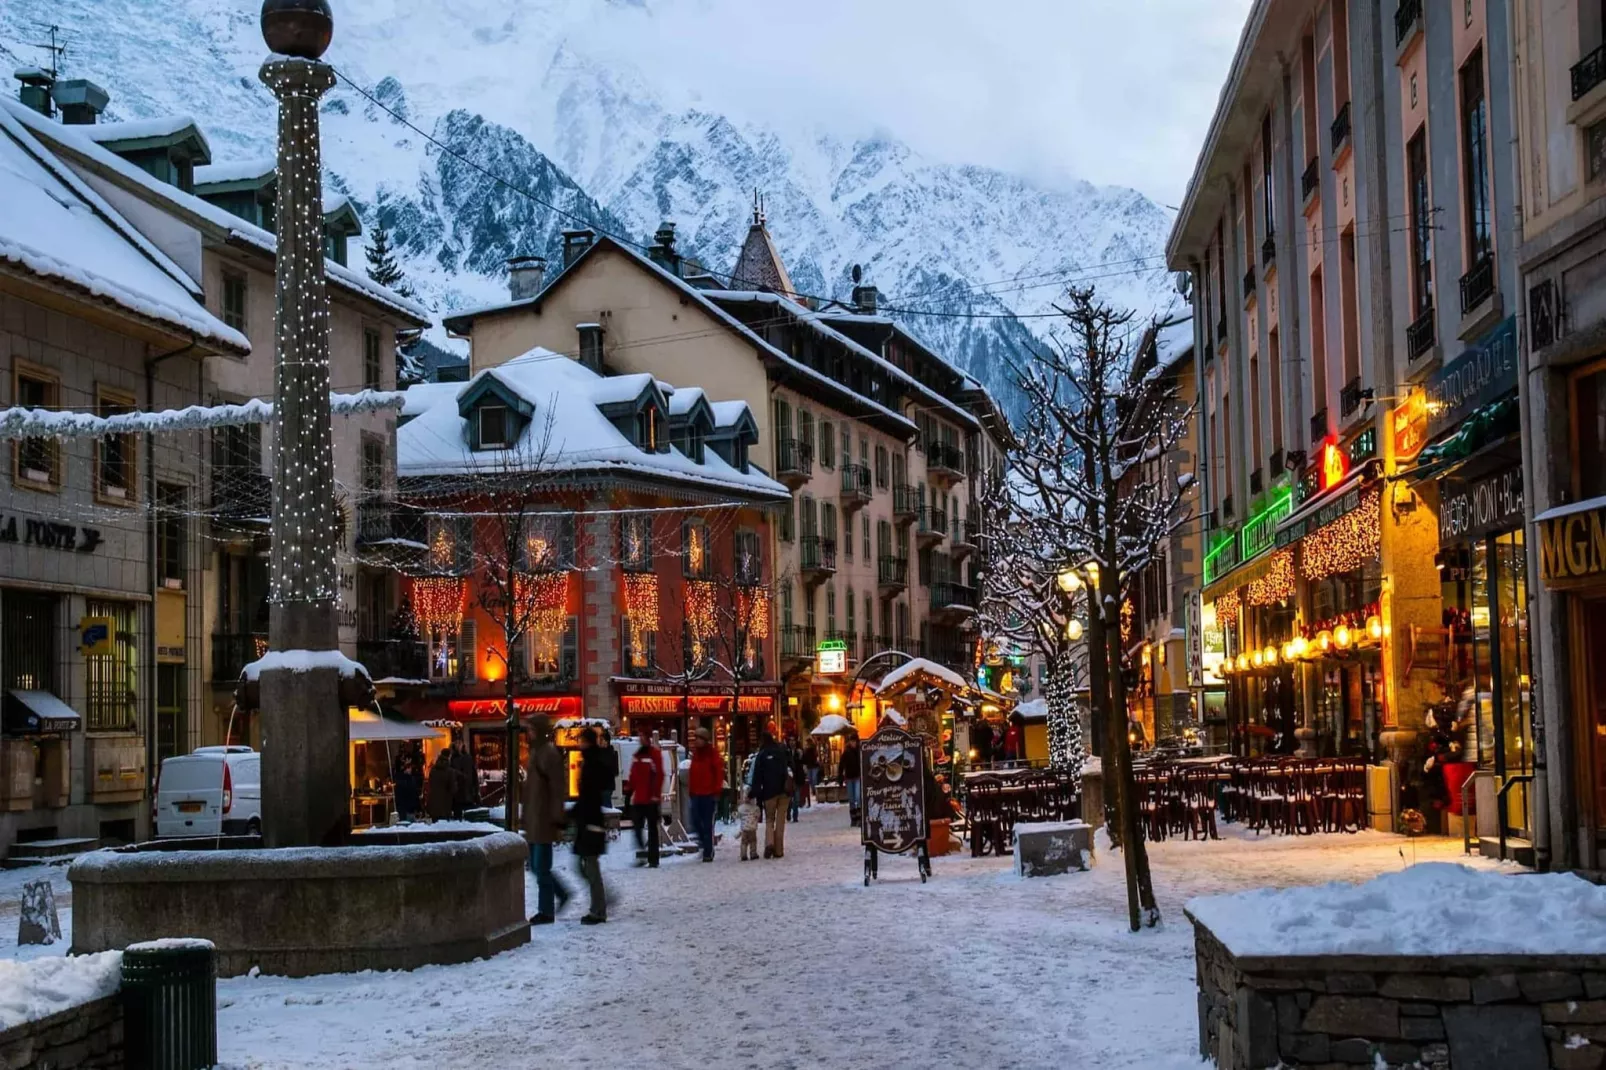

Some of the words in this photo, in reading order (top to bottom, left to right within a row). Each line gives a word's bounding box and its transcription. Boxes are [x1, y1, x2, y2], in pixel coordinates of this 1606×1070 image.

[1441, 493, 1469, 540] PHOTO
[1473, 478, 1499, 528] MONT
[1503, 466, 1526, 517] BLA
[25, 518, 77, 550] POSTE
[1191, 594, 1200, 682] CINEMA
[647, 685, 673, 694] BRASSERIE
[468, 701, 482, 715] le
[487, 697, 562, 716] Nional
[627, 698, 678, 714] BRASSERIE
[727, 699, 772, 712] RSTAURANT
